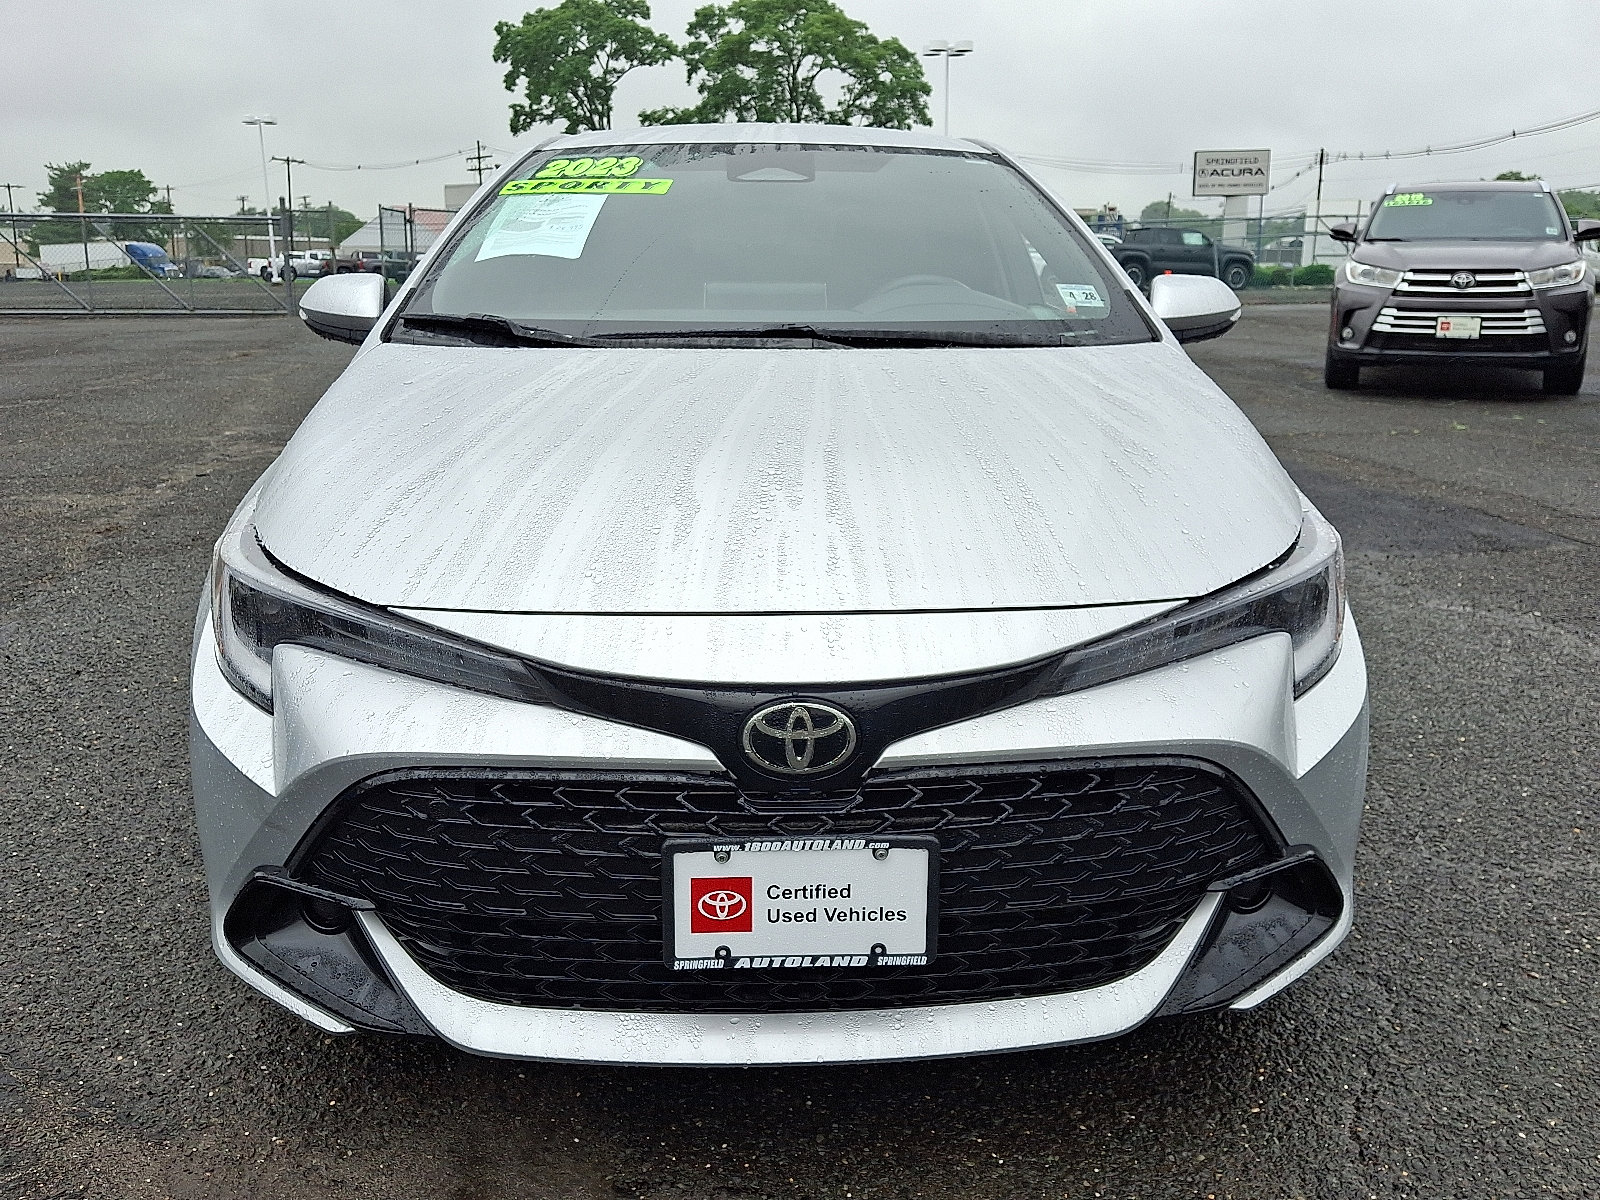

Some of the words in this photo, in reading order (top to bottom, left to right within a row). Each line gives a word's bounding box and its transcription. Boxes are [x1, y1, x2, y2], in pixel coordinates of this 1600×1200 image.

[535, 156, 643, 179] 2023
[1209, 168, 1266, 177] ACURA
[505, 179, 662, 192] SPORTY
[1082, 291, 1097, 301] 28
[713, 839, 890, 852] www.1800AUTOLAND.com
[766, 884, 852, 900] Certified
[766, 908, 818, 924] Used
[823, 906, 908, 923] Vehicles
[673, 958, 725, 971] SPRINGFIELD
[733, 956, 869, 969] AUTOLAND
[877, 955, 928, 966] SPRINGFIELD
